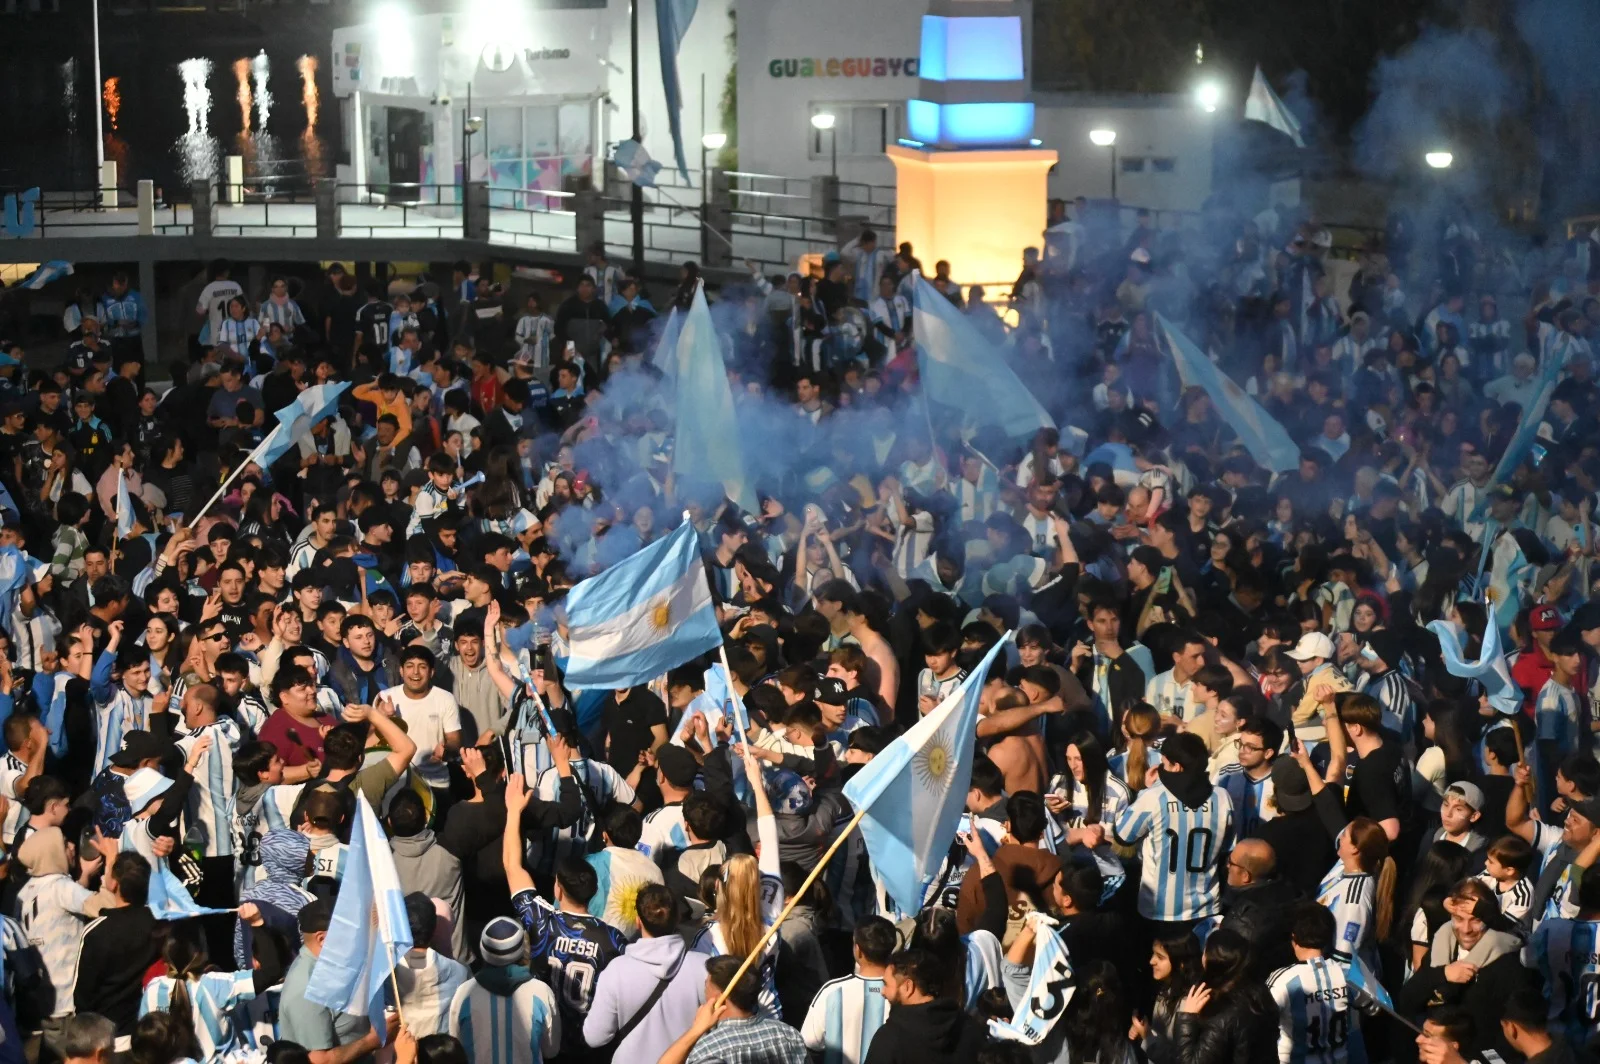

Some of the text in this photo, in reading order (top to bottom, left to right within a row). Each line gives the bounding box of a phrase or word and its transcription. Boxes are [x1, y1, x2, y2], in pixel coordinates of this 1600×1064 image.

[524, 48, 570, 61] Turismo
[769, 57, 920, 78] GUaLeGUaYC
[373, 321, 388, 345] 10
[1166, 828, 1212, 873] 10
[554, 936, 599, 958] MESSI
[547, 955, 596, 1014] 10
[1304, 986, 1348, 1004] MESSI
